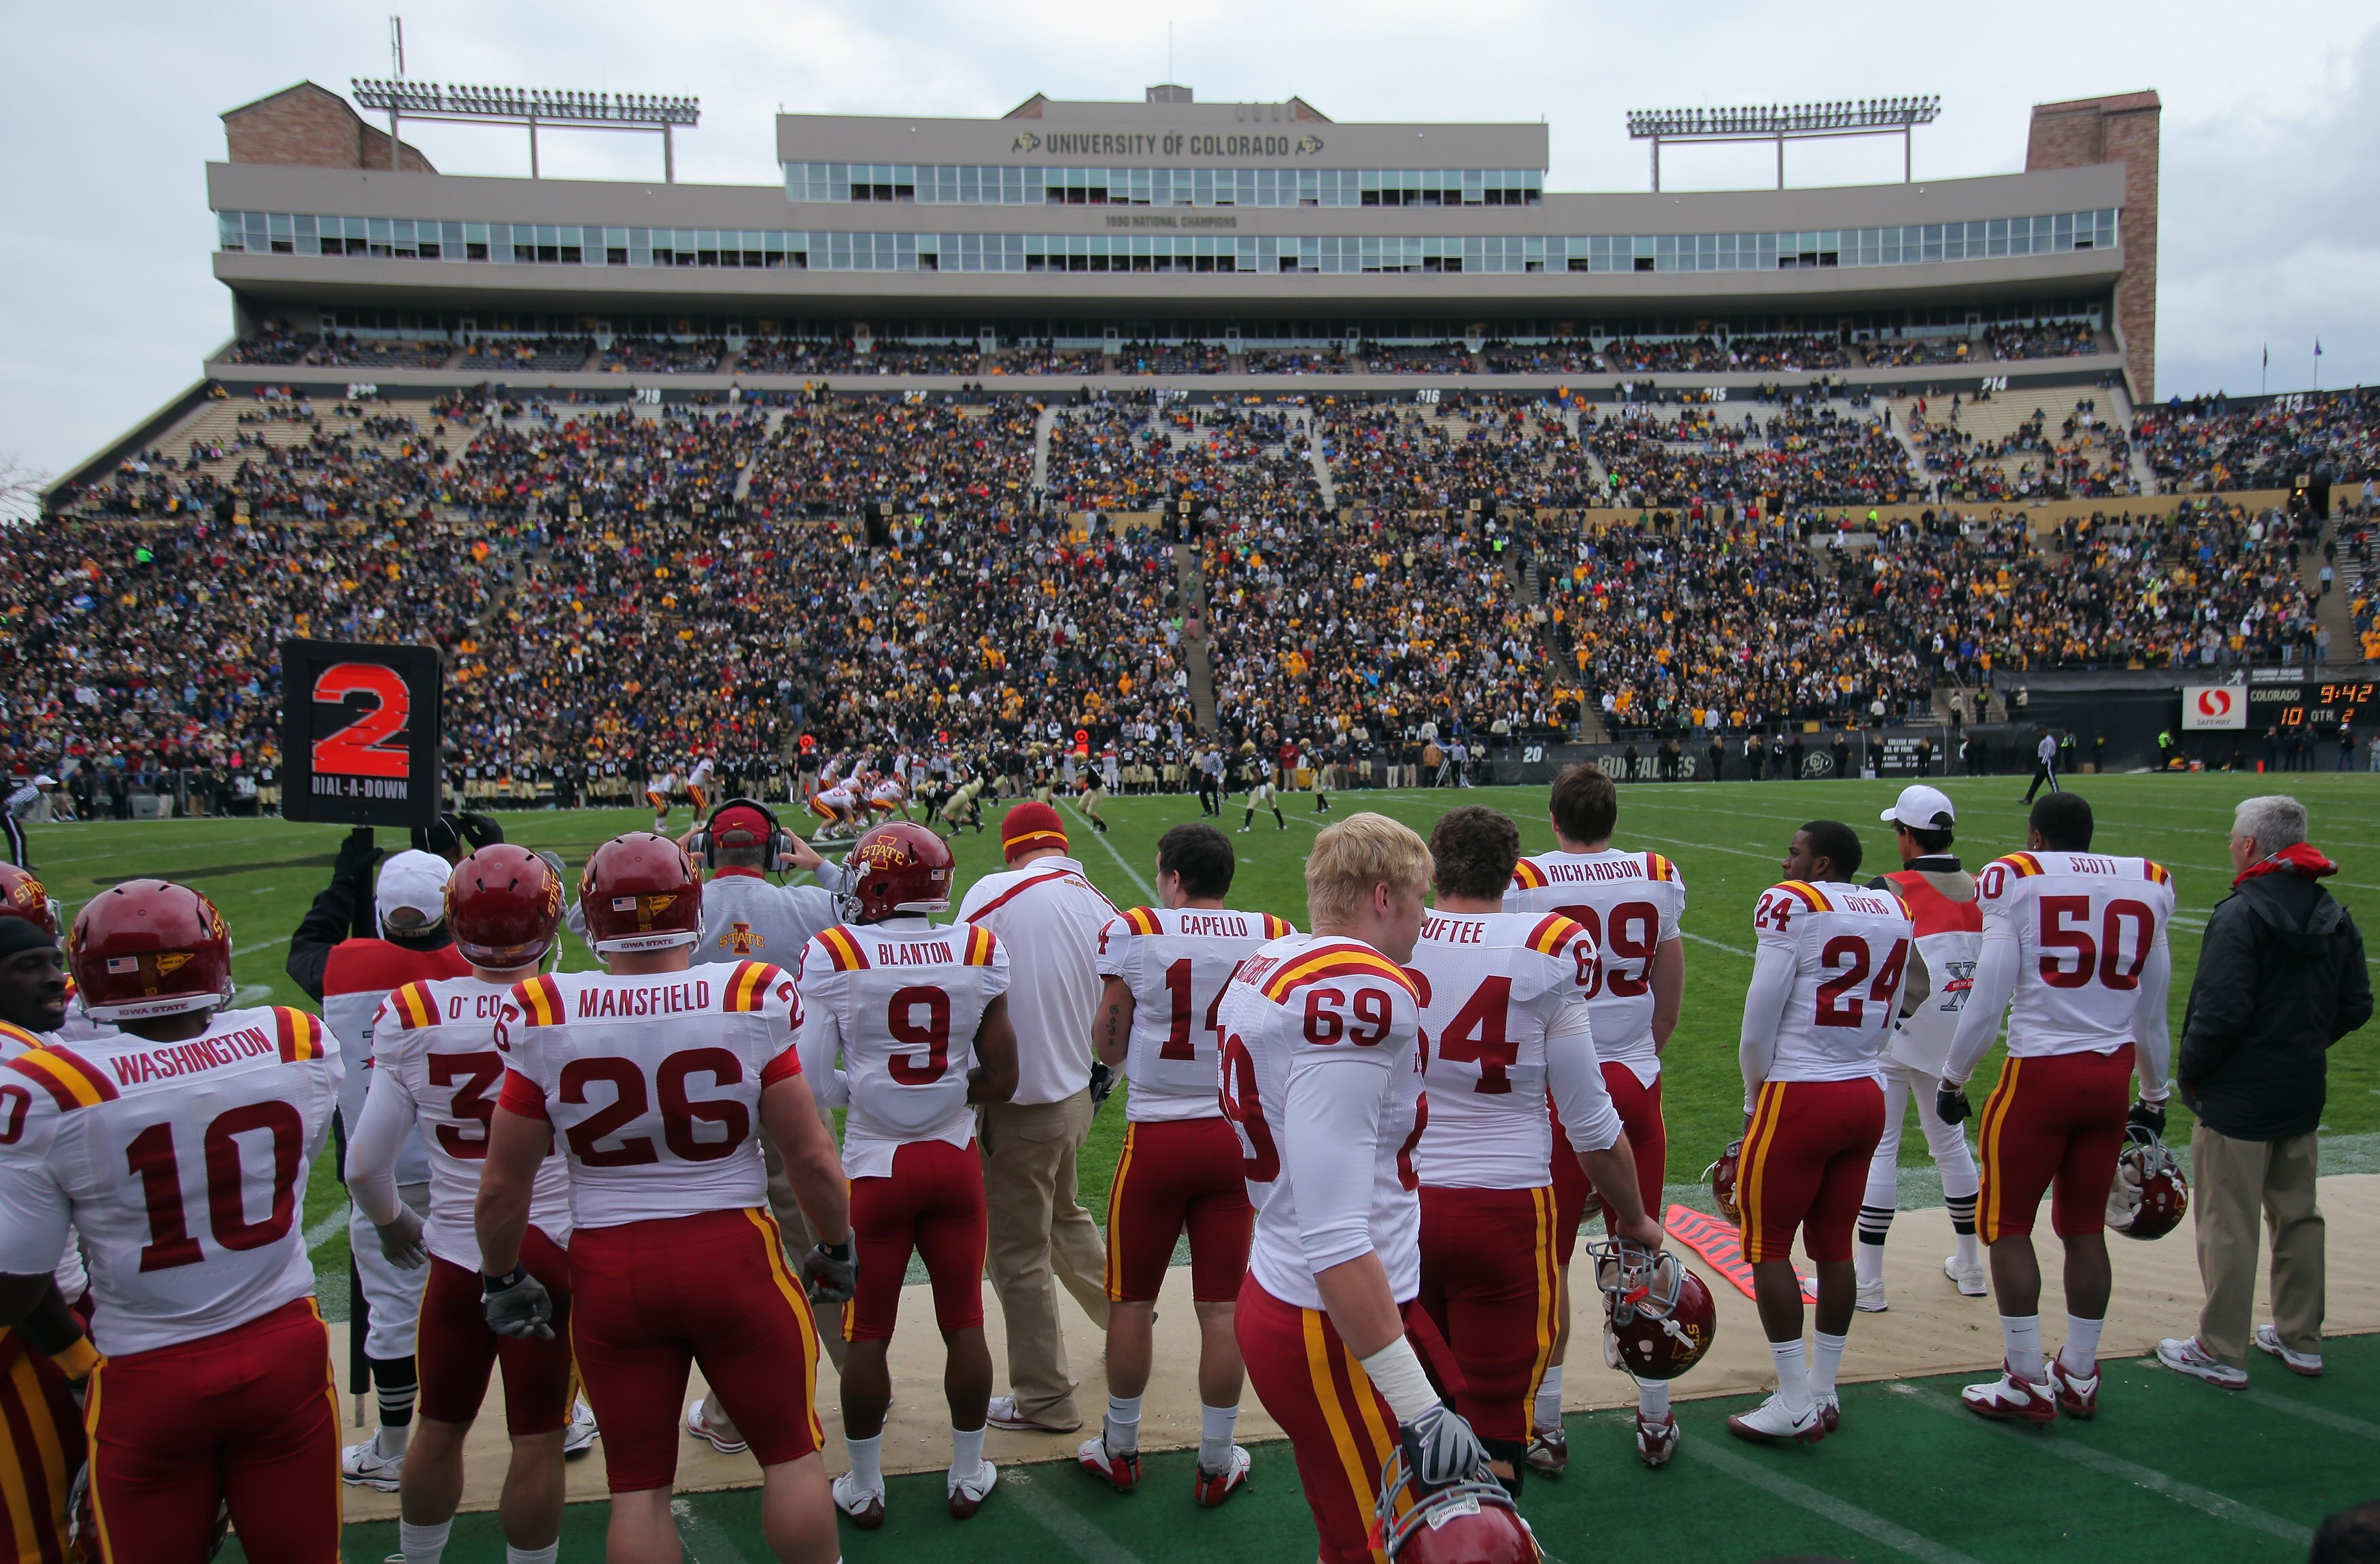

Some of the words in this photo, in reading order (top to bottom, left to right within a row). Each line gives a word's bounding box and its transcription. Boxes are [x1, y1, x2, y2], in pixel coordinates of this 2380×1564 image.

[1047, 135, 1155, 155] UNIVERSITY
[1163, 135, 1183, 156] OF
[1190, 135, 1289, 156] COLORADO
[1133, 216, 1177, 227] NATIONAL
[1181, 216, 1237, 228] CHAMPIONS
[1981, 377, 2007, 392] 214
[2250, 690, 2300, 702] COLORADO
[2320, 684, 2374, 703] 9:42
[312, 662, 410, 778] 2
[2196, 719, 2231, 727] SAFEWAY
[2281, 707, 2304, 726] 10
[2311, 709, 2337, 722] QTR.
[2341, 708, 2356, 722] 2
[1908, 738, 1920, 746] FOOT
[1523, 747, 1542, 763] 20
[1598, 757, 1695, 779] BUFALES
[312, 776, 407, 800] DIAL-A-DOWN
[862, 845, 905, 866] STATE
[2069, 857, 2116, 875] SCOTT
[1548, 860, 1642, 883] RICHARDSON
[1754, 893, 1793, 932] 24
[1842, 894, 1890, 915] GIVENS
[1098, 919, 1116, 955] 4
[1180, 915, 1248, 937] CAPELLO
[1421, 917, 1486, 944] UFTEE
[621, 940, 644, 949] IOWA
[647, 938, 674, 947] STATE
[719, 933, 765, 949] STATE
[2039, 895, 2155, 991] 50
[878, 942, 953, 966] BLANTON
[1573, 940, 1595, 987] 6
[144, 987, 157, 996] 10
[1814, 935, 1909, 1029] 24
[119, 1007, 148, 1016] IOWA
[152, 1004, 188, 1013] STATE
[476, 994, 502, 1019] CO
[579, 981, 709, 1018] MANSFIELD
[777, 981, 804, 1032] 2
[493, 1003, 520, 1053] 6
[1304, 987, 1392, 1047] 69
[887, 985, 951, 1086] 9
[110, 1027, 274, 1086] WASHINGTON
[0, 1084, 33, 1145] 0
[427, 1051, 505, 1159] 3
[560, 1047, 749, 1168] 26
[126, 1100, 303, 1273] 10
